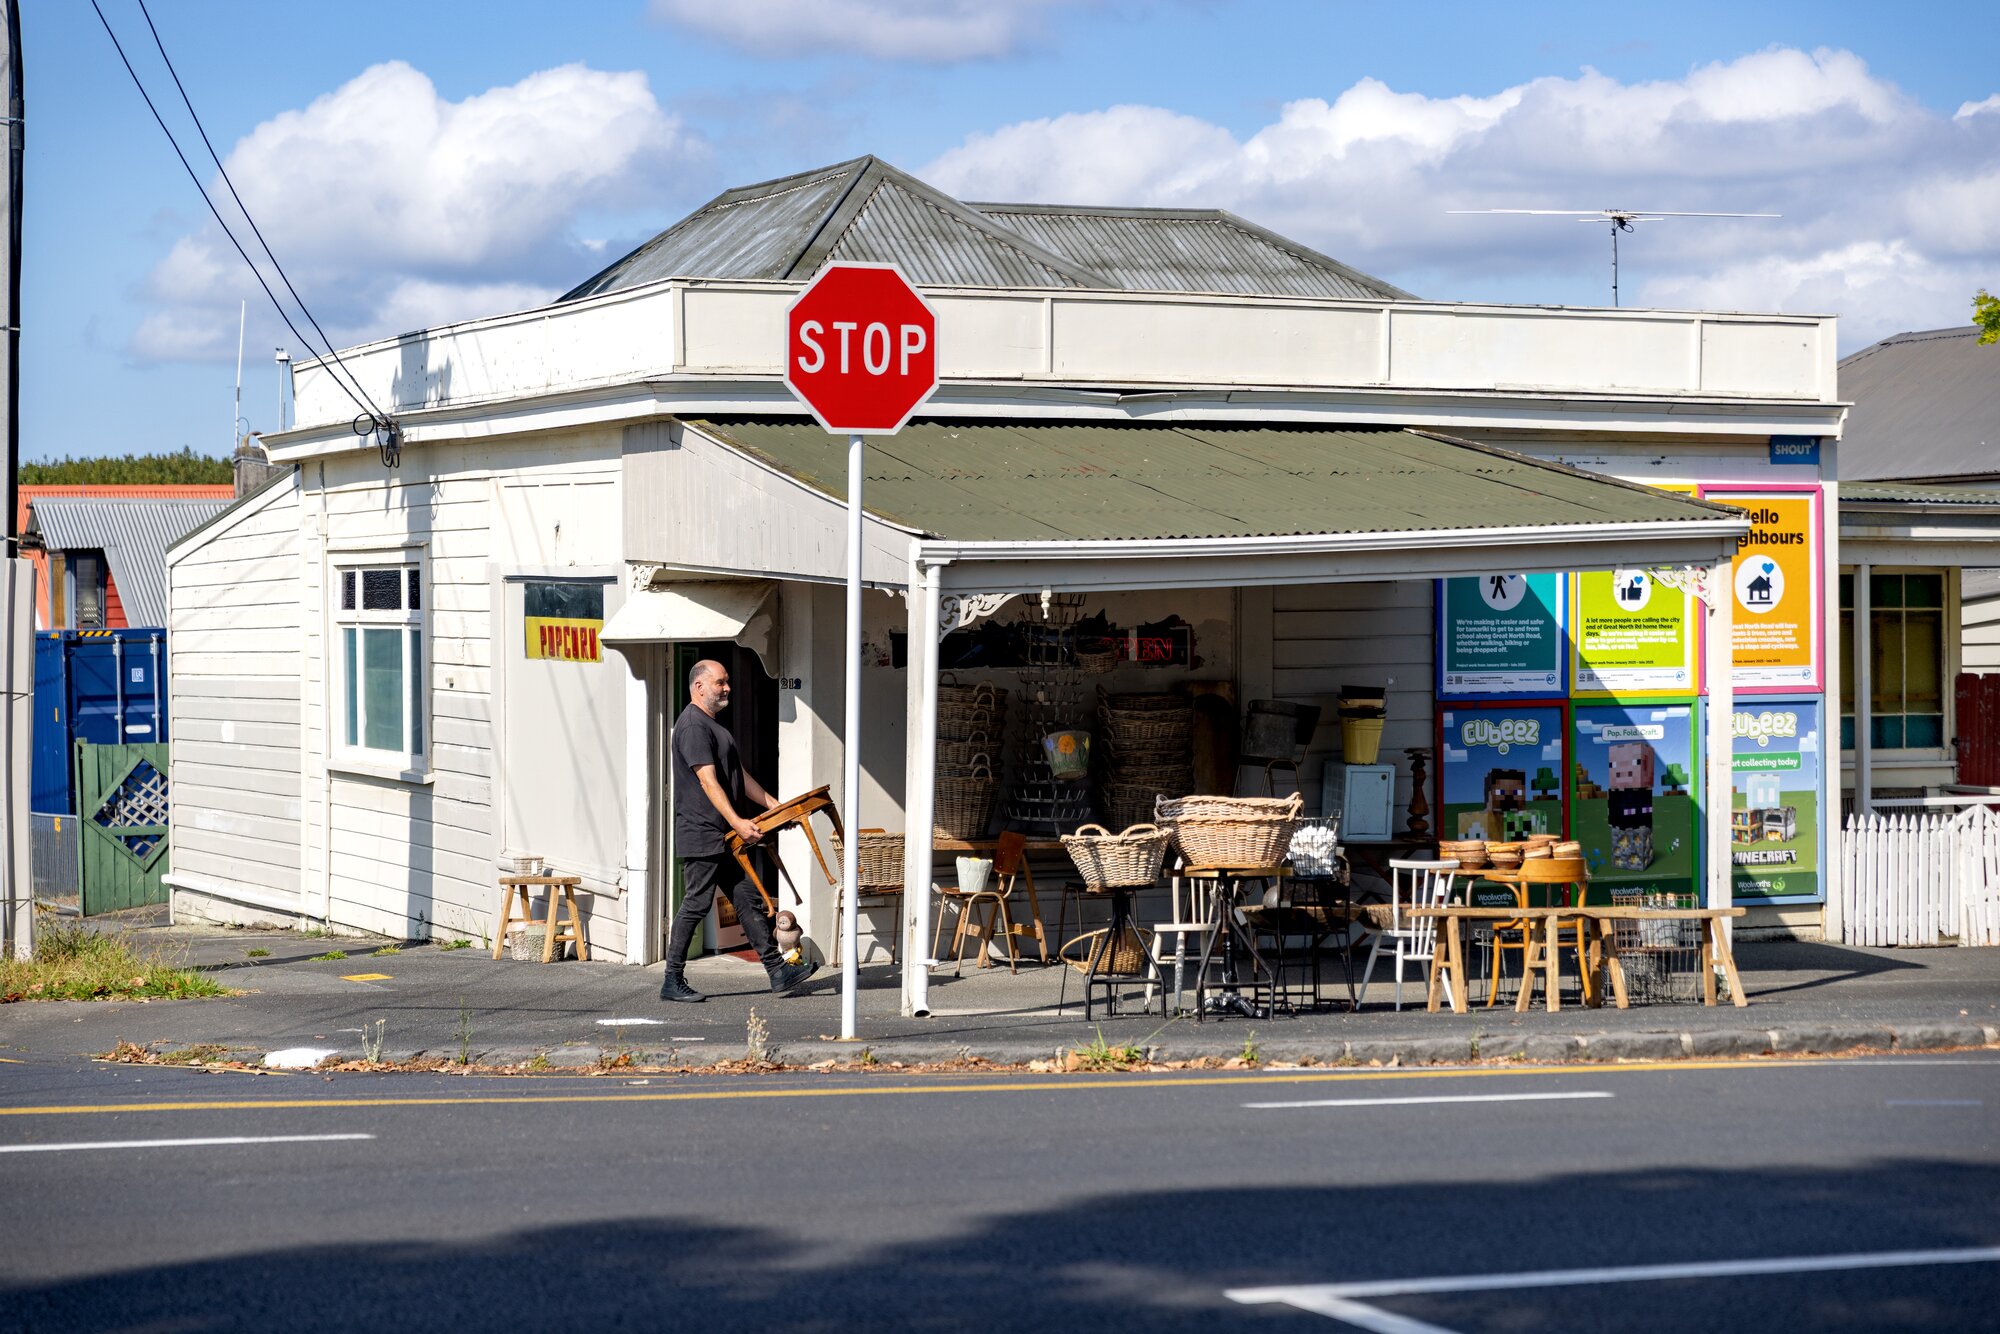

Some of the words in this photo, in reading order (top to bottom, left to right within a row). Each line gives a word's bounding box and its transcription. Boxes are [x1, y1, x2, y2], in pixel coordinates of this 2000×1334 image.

[798, 320, 927, 376] STOP
[1775, 444, 1811, 455] SHOUT
[1748, 509, 1779, 524] ello
[540, 625, 598, 661] POPCORN
[1607, 730, 1621, 738] Pop.
[1741, 758, 1777, 768] collecting
[1777, 757, 1798, 767] today
[1738, 879, 1771, 889] Woolworths
[1610, 886, 1644, 896] Woolworths
[1477, 892, 1513, 902] Woolworths
